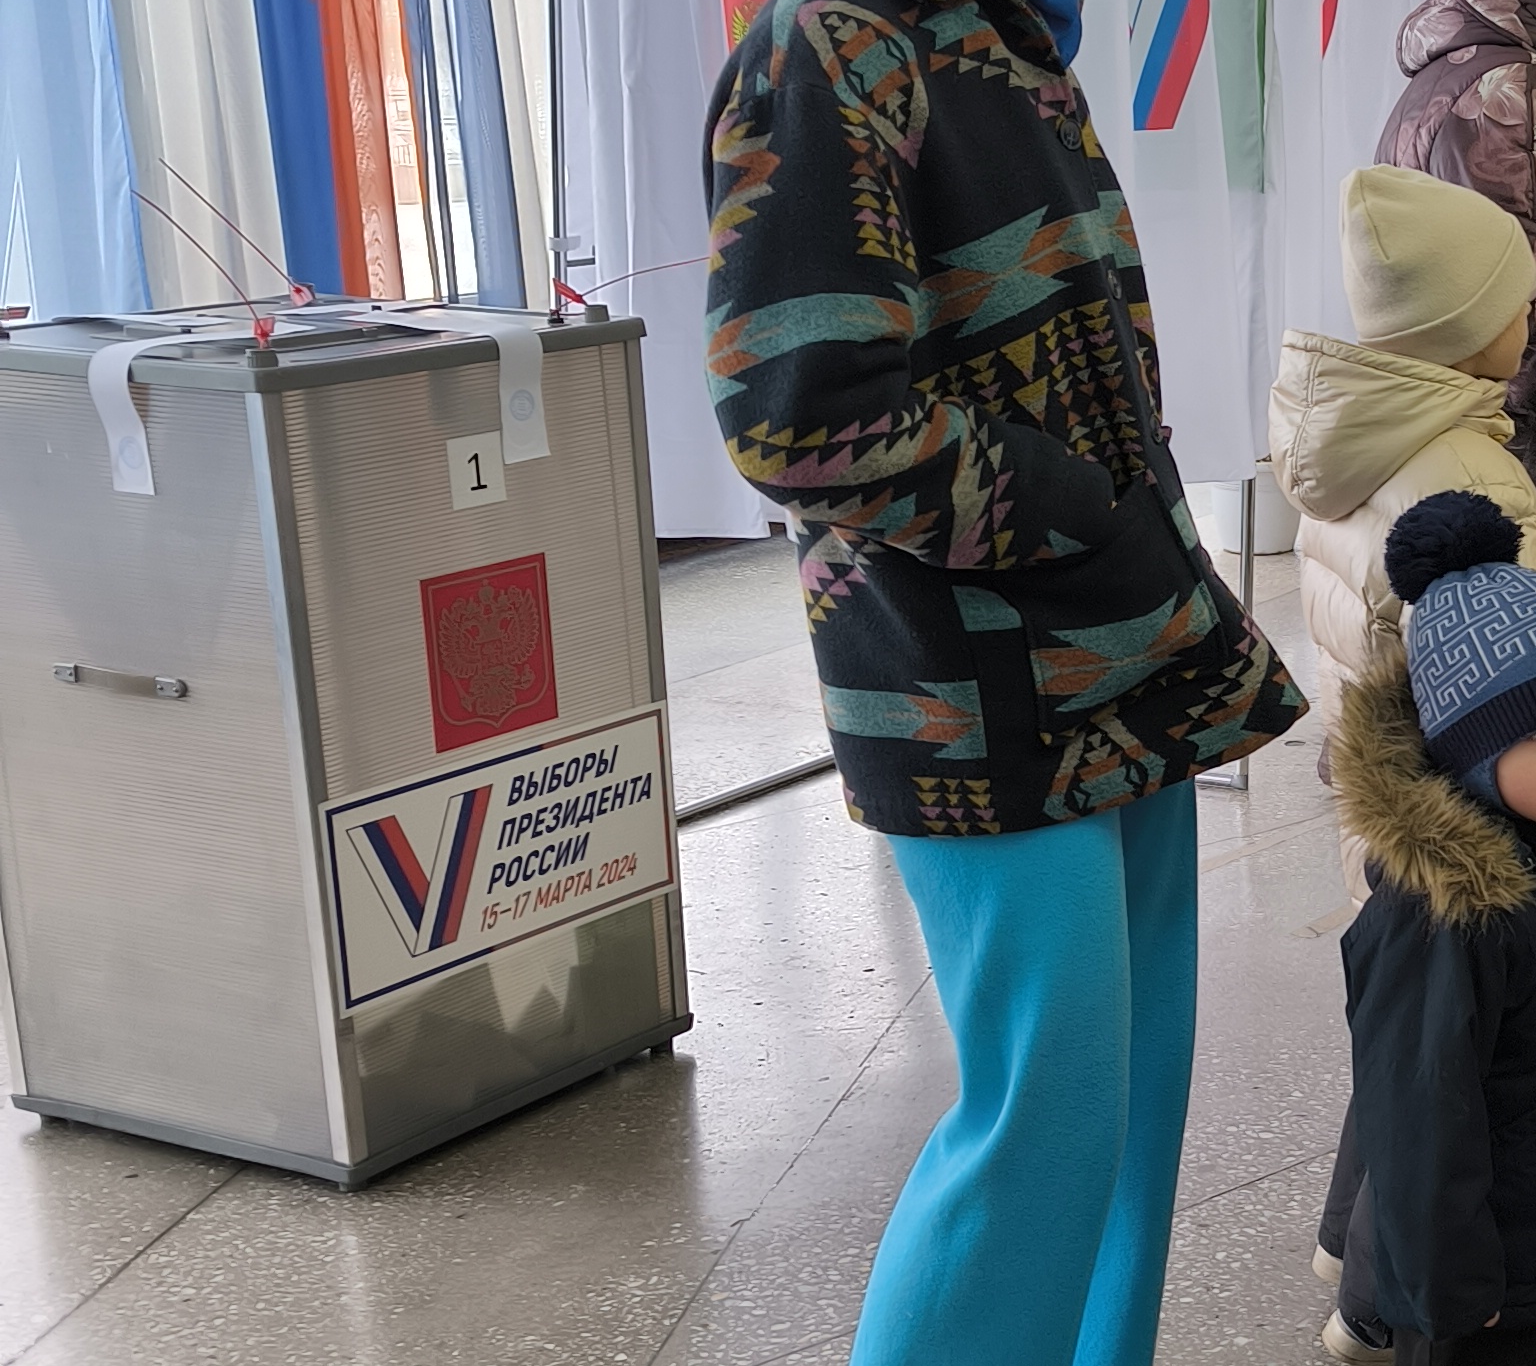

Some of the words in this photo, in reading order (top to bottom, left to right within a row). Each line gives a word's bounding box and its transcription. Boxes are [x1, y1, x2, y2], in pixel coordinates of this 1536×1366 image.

[467, 452, 488, 491] 1
[507, 745, 619, 806] ВЫБОРЫ
[497, 772, 652, 850] ПРЕЗИДЕНТА
[486, 832, 590, 894] РОССИИ
[533, 868, 593, 912] МАРТА
[595, 852, 639, 889] 2024
